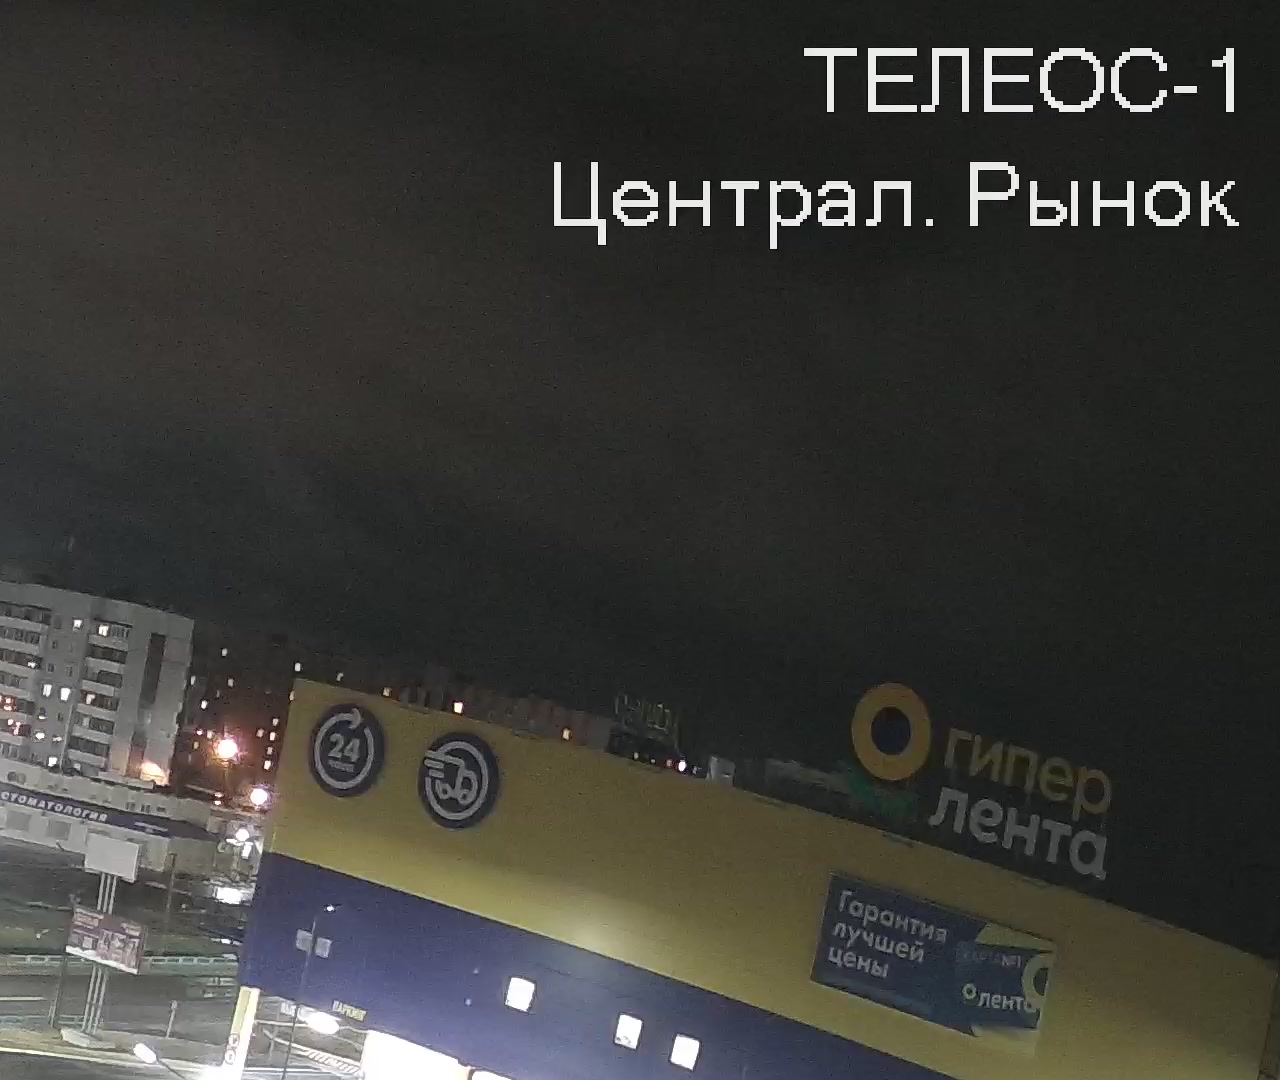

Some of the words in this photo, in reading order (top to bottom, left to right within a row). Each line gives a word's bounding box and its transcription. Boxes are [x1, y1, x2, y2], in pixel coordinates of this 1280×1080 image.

[327, 732, 361, 762] 24
[944, 728, 1112, 822] гипер
[0, 791, 109, 823] СТОМАТОЛОГИЯ
[928, 786, 1107, 881] лента
[839, 890, 948, 943] Гарантия
[827, 947, 889, 979] цены
[831, 921, 925, 963] лучшей
